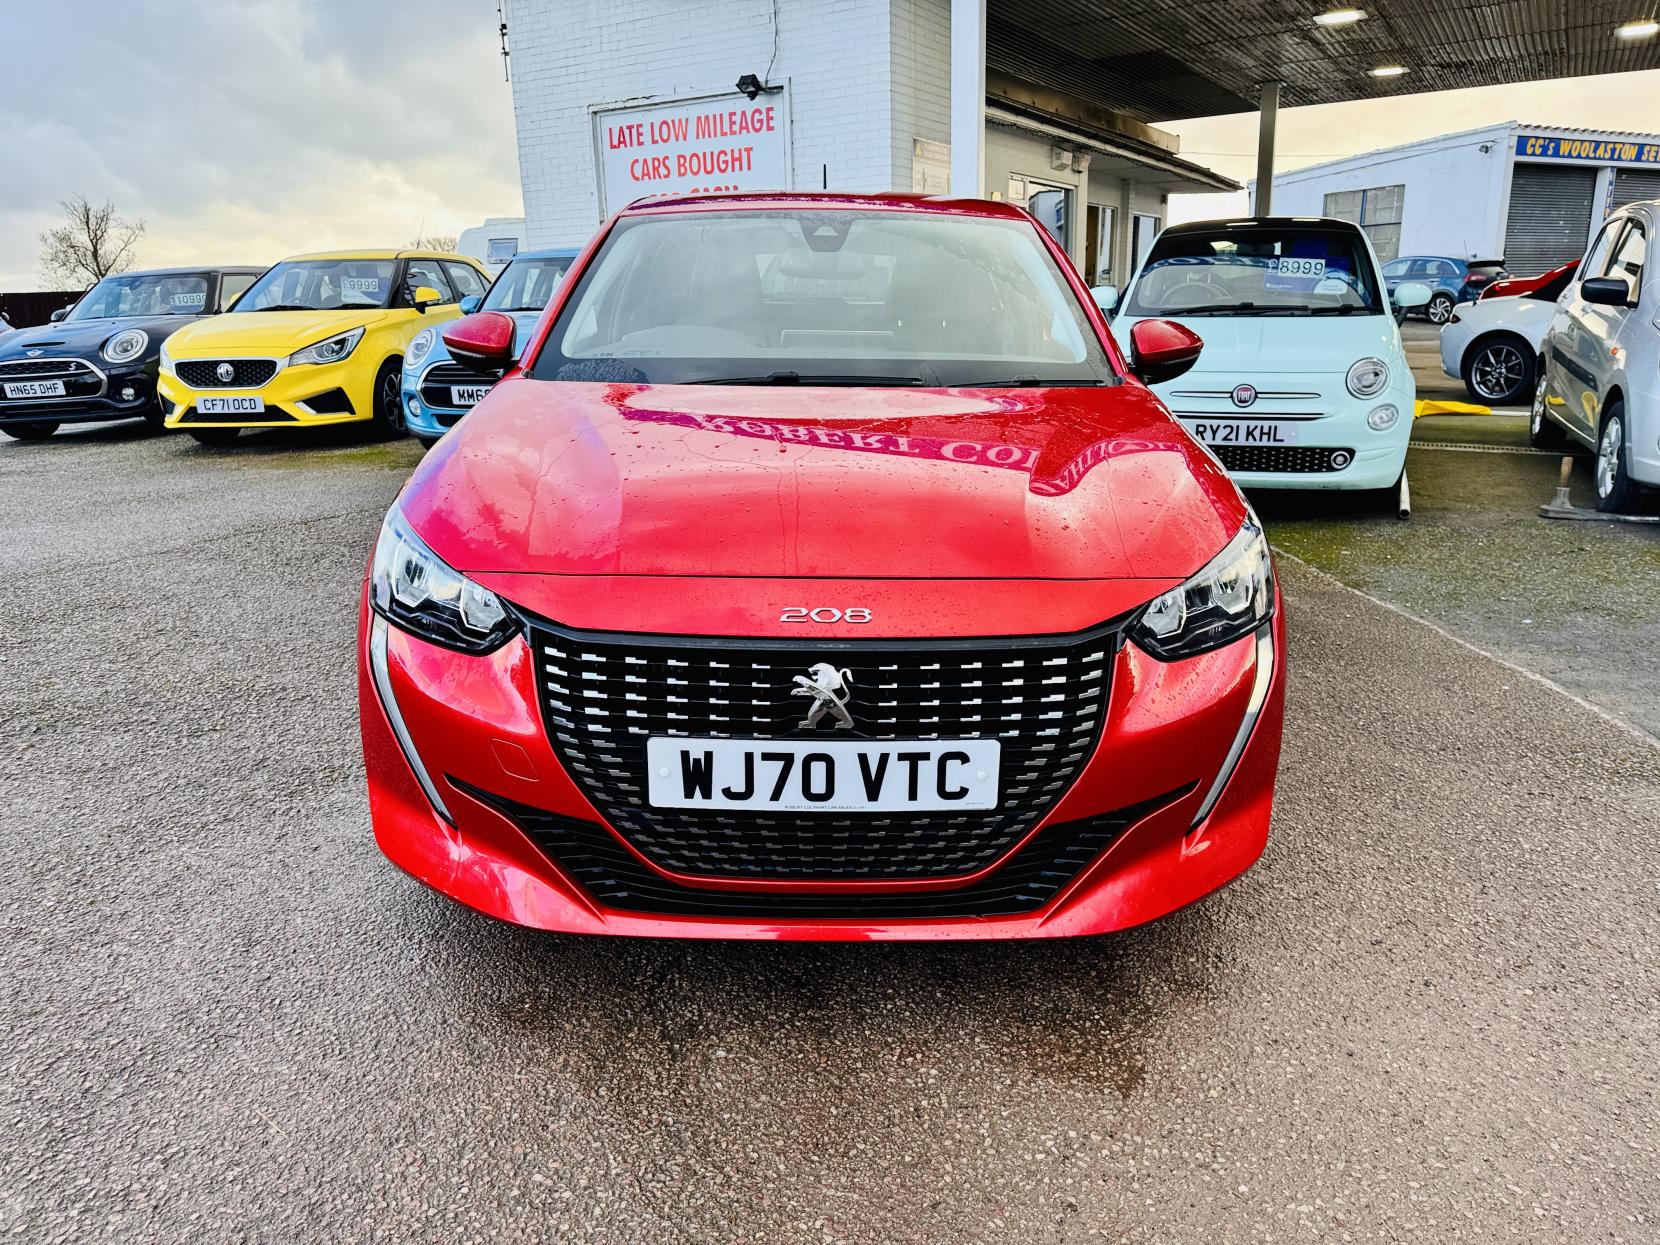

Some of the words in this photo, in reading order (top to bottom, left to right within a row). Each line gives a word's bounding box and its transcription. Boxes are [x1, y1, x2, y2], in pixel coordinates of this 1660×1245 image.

[608, 123, 644, 149] LATE
[650, 117, 689, 144] LOW
[695, 106, 775, 140] MILEAGE
[1526, 137, 1555, 156] CC's
[1559, 139, 1638, 161] WOOLASTON
[630, 155, 671, 181] CARS
[677, 146, 753, 177] BOUGHT
[9, 385, 37, 396] HN65
[38, 383, 59, 394] DHF
[1238, 391, 1252, 401] FIAT
[203, 398, 230, 411] CF71
[232, 398, 257, 410] OCD
[1195, 424, 1240, 442] RY21
[1245, 425, 1285, 443] KHL
[779, 607, 873, 623] 208
[680, 750, 835, 803] WJ70
[857, 751, 971, 802] VTC
